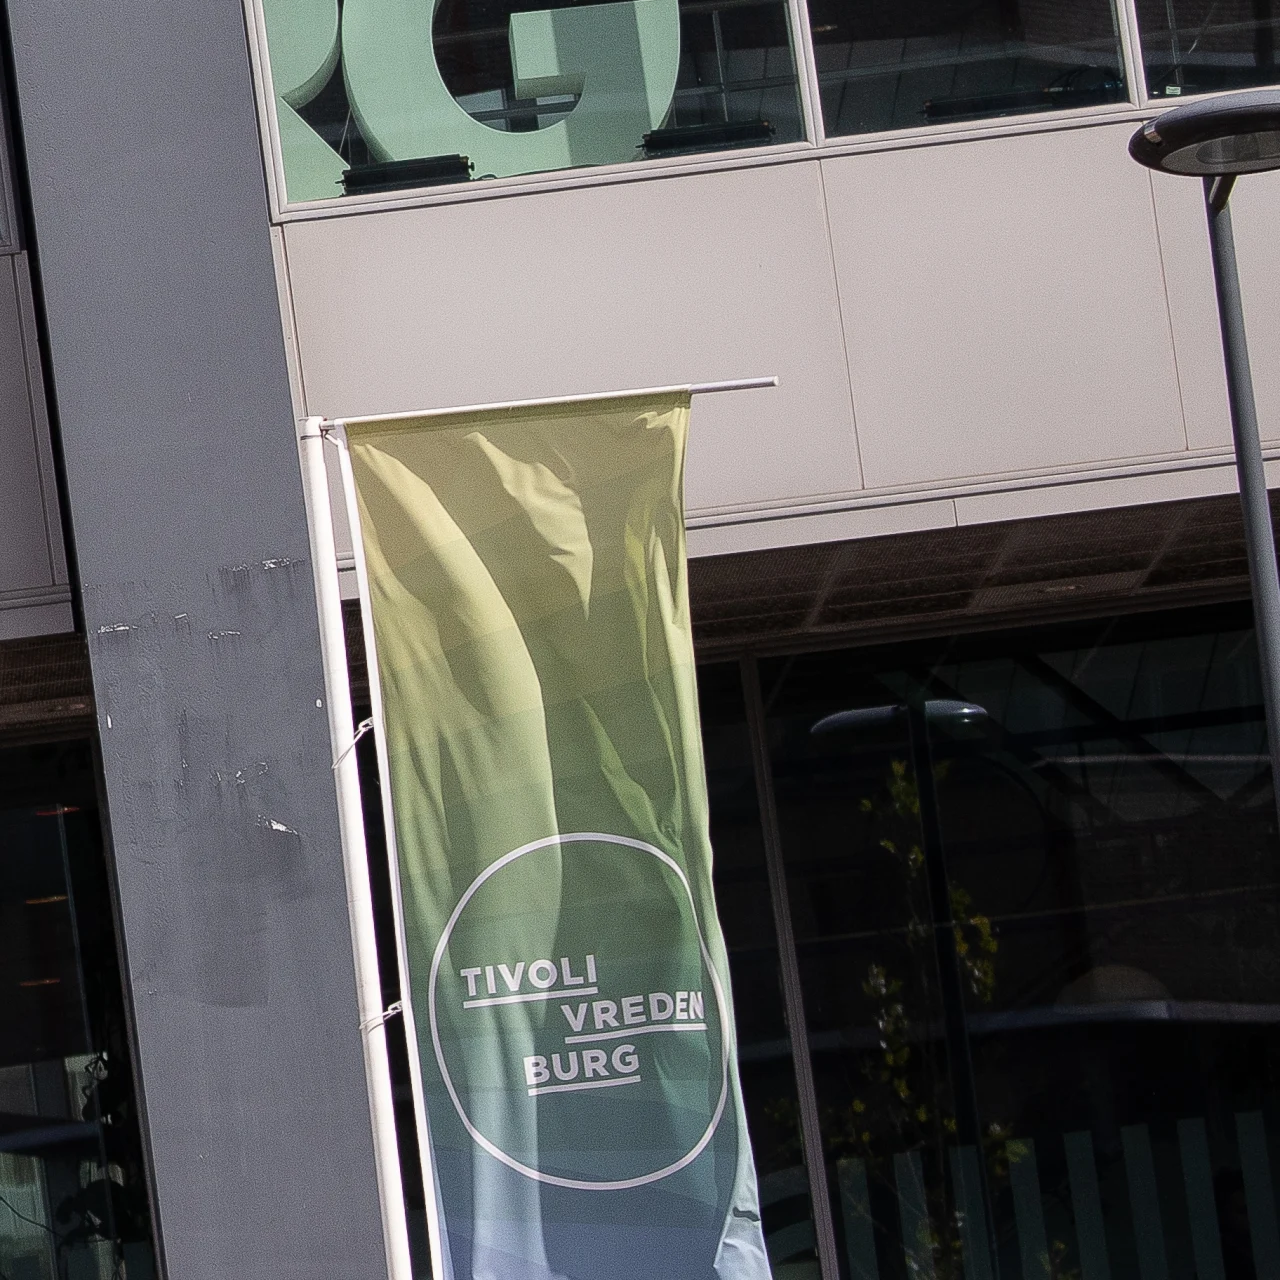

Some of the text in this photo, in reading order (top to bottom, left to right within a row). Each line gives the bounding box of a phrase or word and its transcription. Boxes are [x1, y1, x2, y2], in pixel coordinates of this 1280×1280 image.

[460, 954, 597, 997] TIVOLI
[560, 991, 705, 1033] VREDEN
[523, 1043, 640, 1086] BURG
